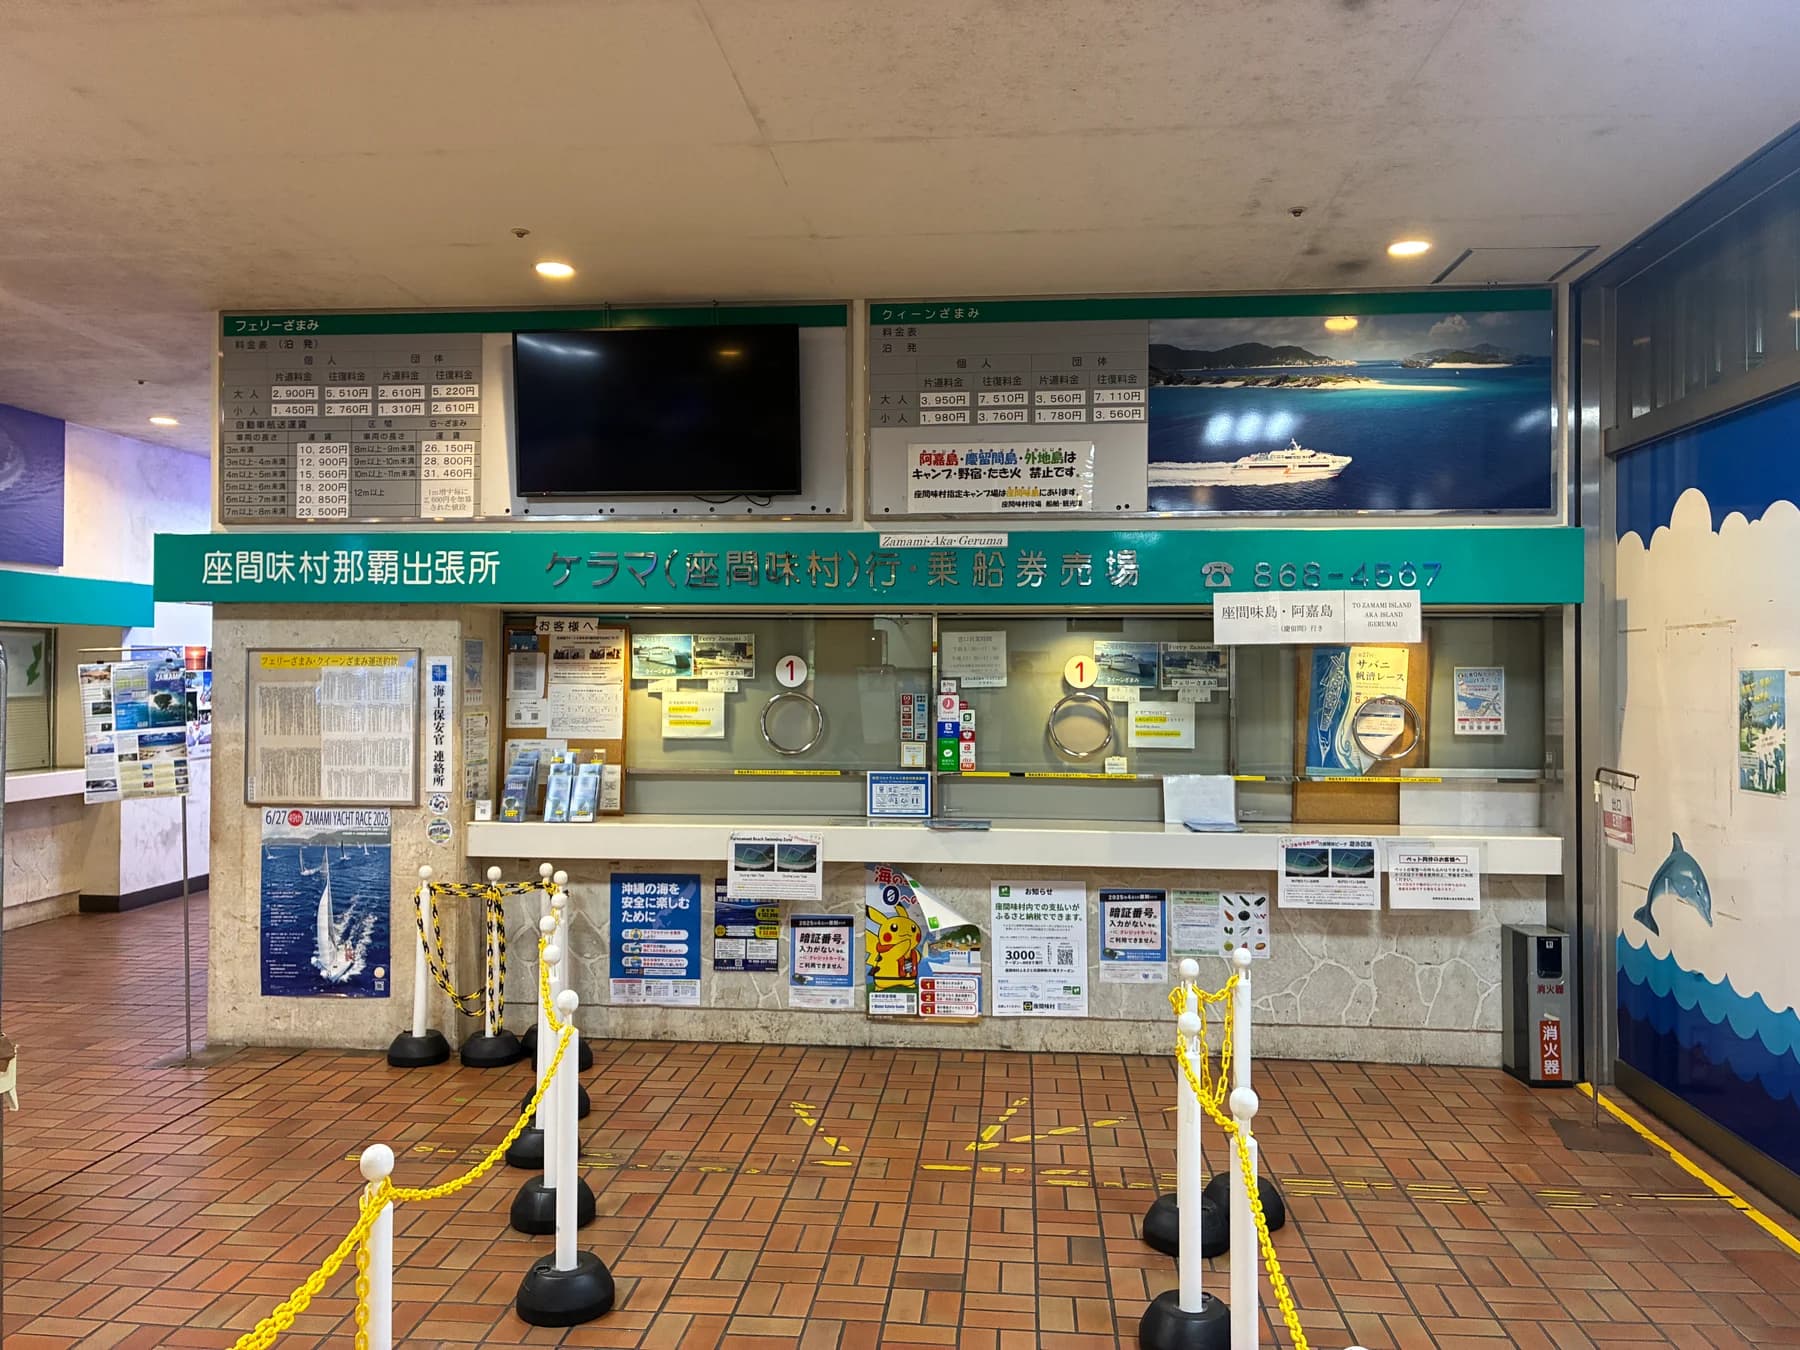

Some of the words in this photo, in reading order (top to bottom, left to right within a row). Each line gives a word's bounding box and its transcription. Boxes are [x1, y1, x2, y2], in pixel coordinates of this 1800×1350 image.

[235, 320, 319, 332] フェリーざまみ
[883, 327, 917, 336] 料金表
[202, 549, 500, 587] 座間味村那覇出張所
[1254, 561, 1441, 587] 868-4567
[1222, 604, 1333, 619] 座間味島・阿嘉島
[539, 621, 593, 632] お客様へ
[788, 660, 794, 680] 1
[1357, 659, 1390, 669] サバニ
[1076, 662, 1083, 682] 1
[433, 685, 445, 746] 海上保安官
[433, 751, 445, 787] 連絡所
[266, 811, 286, 824] 6/27
[305, 811, 331, 825] ZAMAMI
[333, 811, 354, 825] YACHT
[356, 812, 371, 826] RACE
[373, 812, 388, 826] 2026
[622, 883, 680, 894] 沖縄の海を
[622, 897, 690, 909] 安全に楽しむ
[622, 911, 656, 922] ために
[1537, 984, 1564, 994] 消火器
[1543, 1026, 1560, 1074] 消火器
